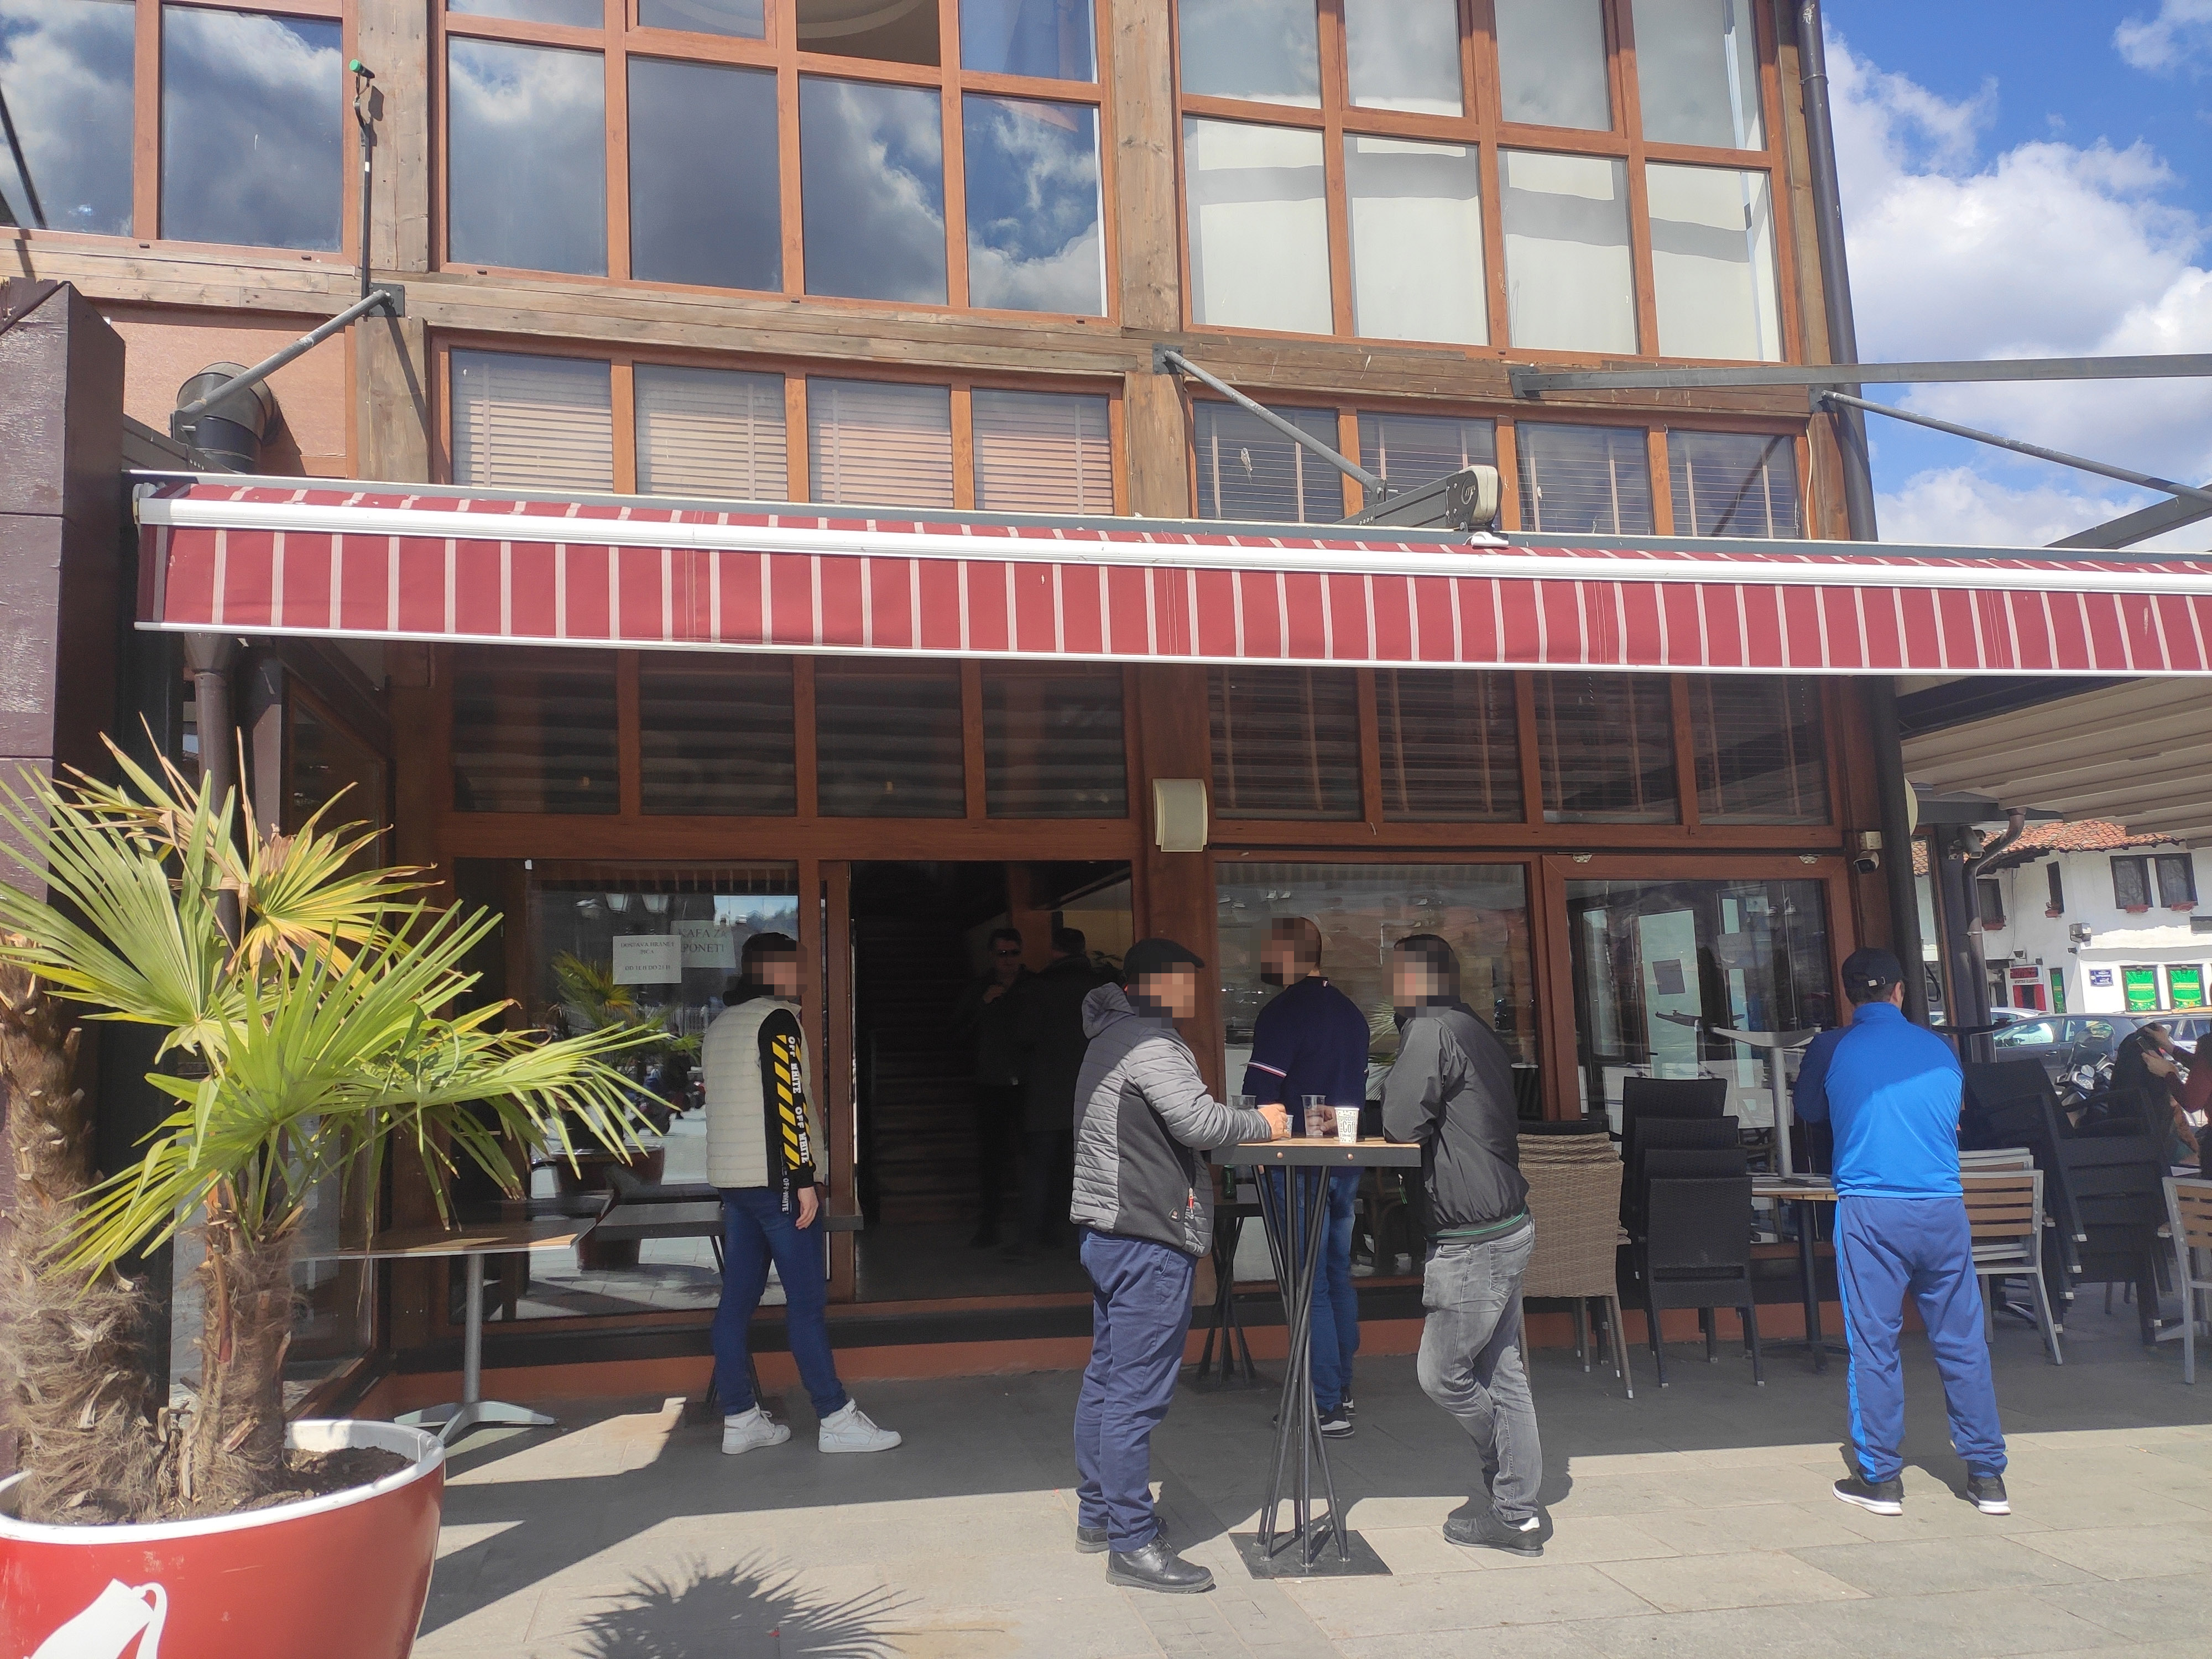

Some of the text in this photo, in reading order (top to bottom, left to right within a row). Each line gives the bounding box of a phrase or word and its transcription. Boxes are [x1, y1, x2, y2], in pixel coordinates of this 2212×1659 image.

[678, 928, 727, 938] KAFA ZA
[681, 943, 724, 953] PONETI
[790, 1062, 801, 1094] WHITE
[795, 1106, 810, 1164] OFF WHITE
